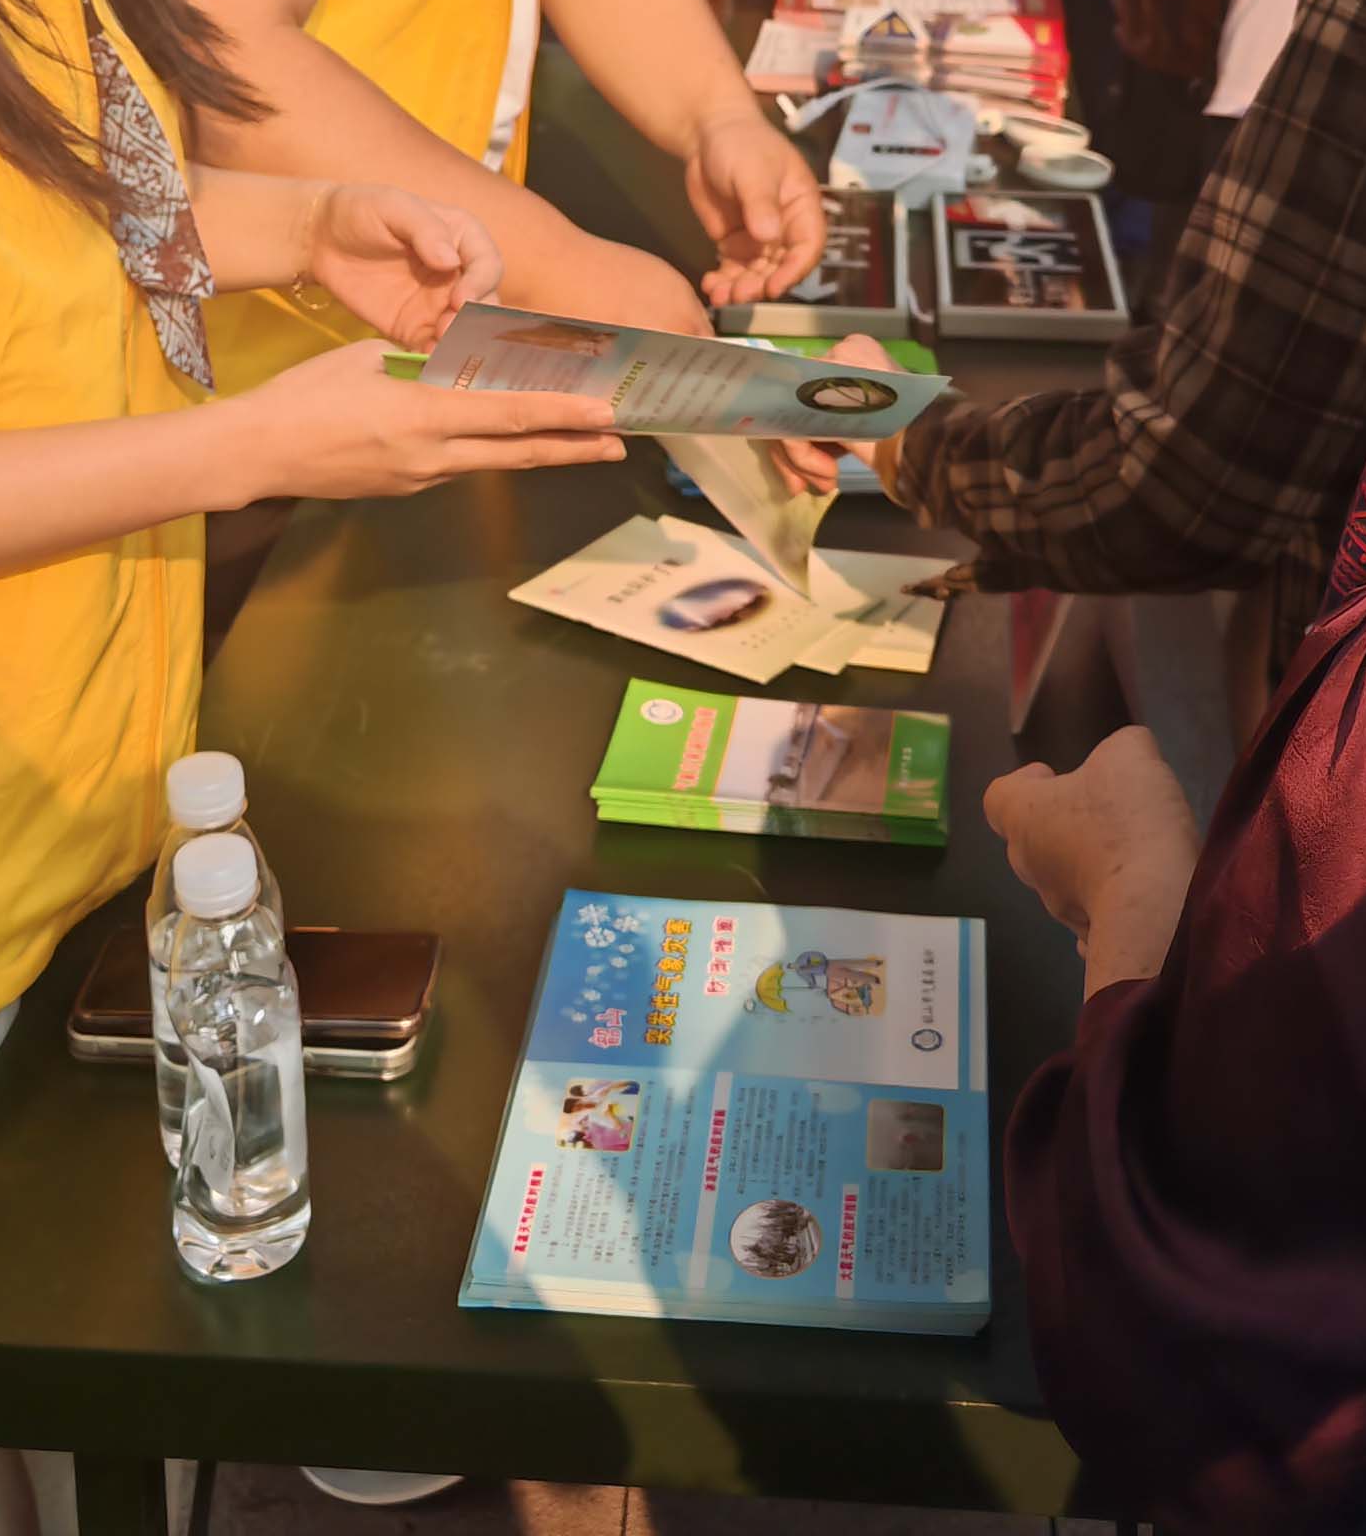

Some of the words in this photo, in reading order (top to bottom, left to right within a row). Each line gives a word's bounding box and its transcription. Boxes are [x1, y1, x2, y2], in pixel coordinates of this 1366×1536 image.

[644, 917, 693, 1046] 突发性气象灾害
[589, 1007, 628, 1049] 韶山
